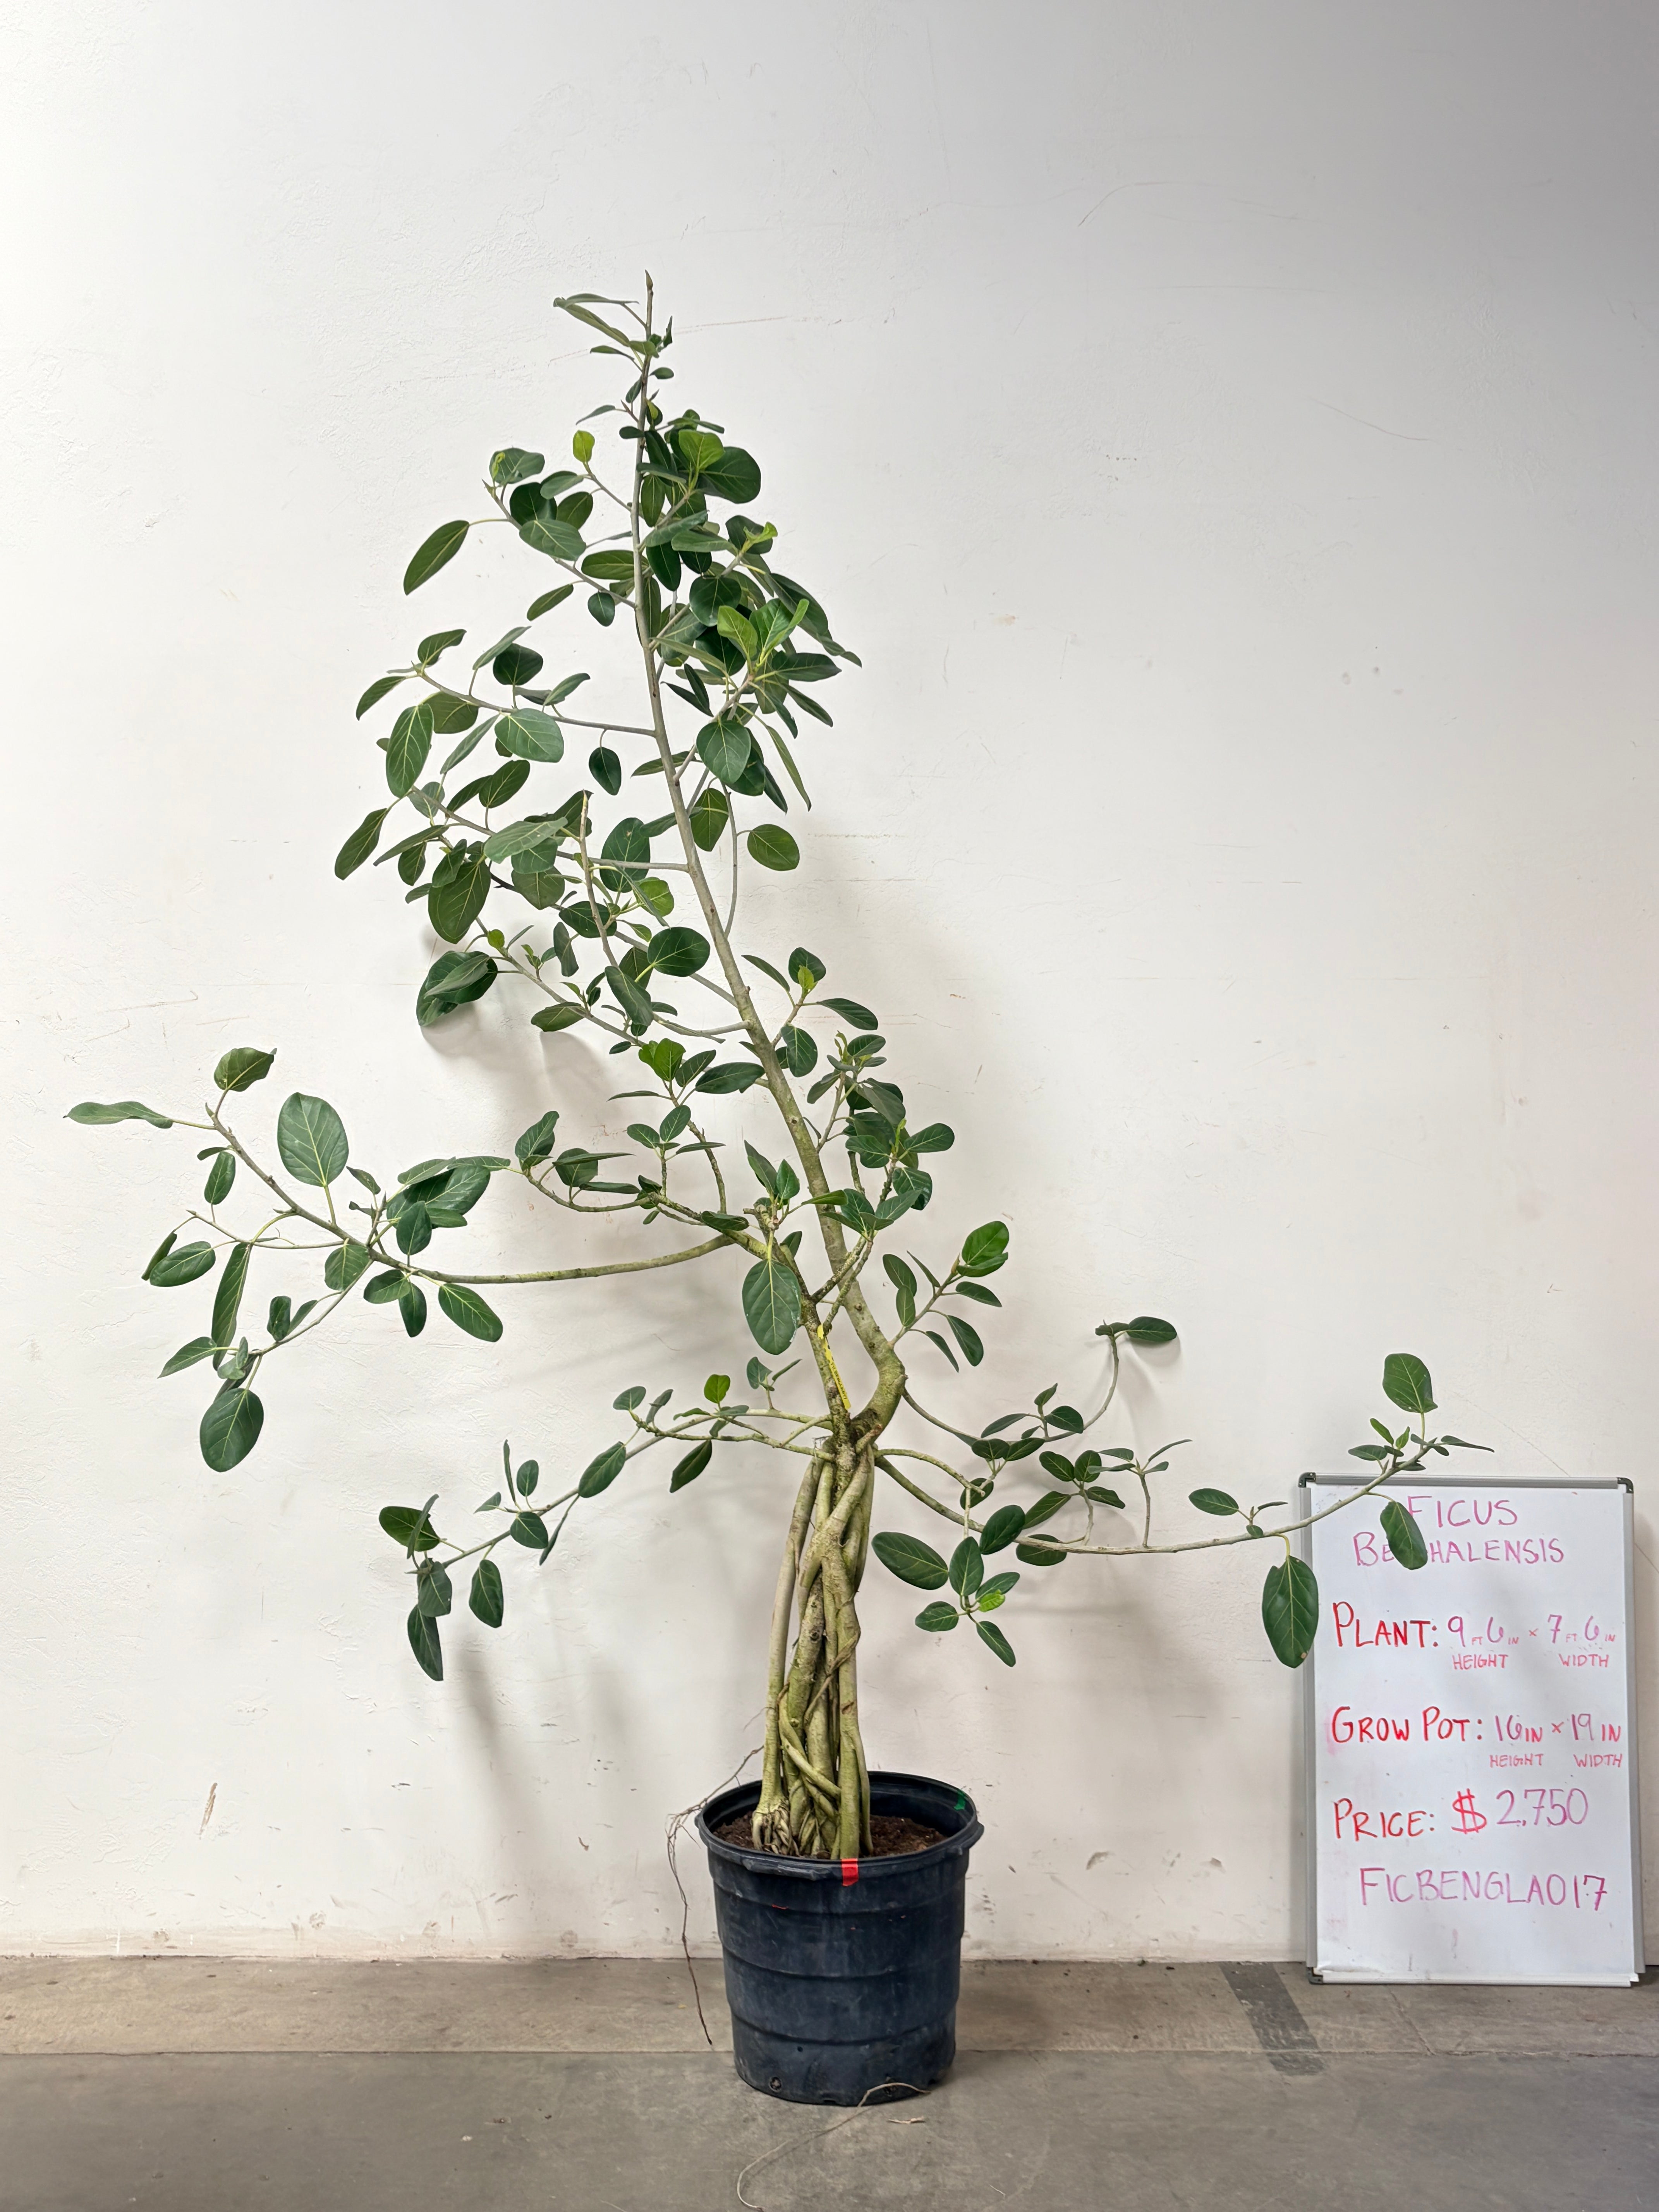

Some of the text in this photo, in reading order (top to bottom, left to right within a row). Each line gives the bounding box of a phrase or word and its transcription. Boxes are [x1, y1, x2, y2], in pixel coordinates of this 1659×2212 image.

[1407, 1495, 1518, 1529] FICUS
[1352, 1531, 1565, 1567] BEHALENSIS
[1332, 1601, 1439, 1649] PLANT:
[1452, 1654, 1610, 1671] HEIGHT WIDTH
[1331, 1706, 1410, 1744] GROW
[1421, 1705, 1483, 1742] POT:
[1489, 1753, 1623, 1769] HEIGHT WIDTH
[1333, 1797, 1435, 1842] PRICE:
